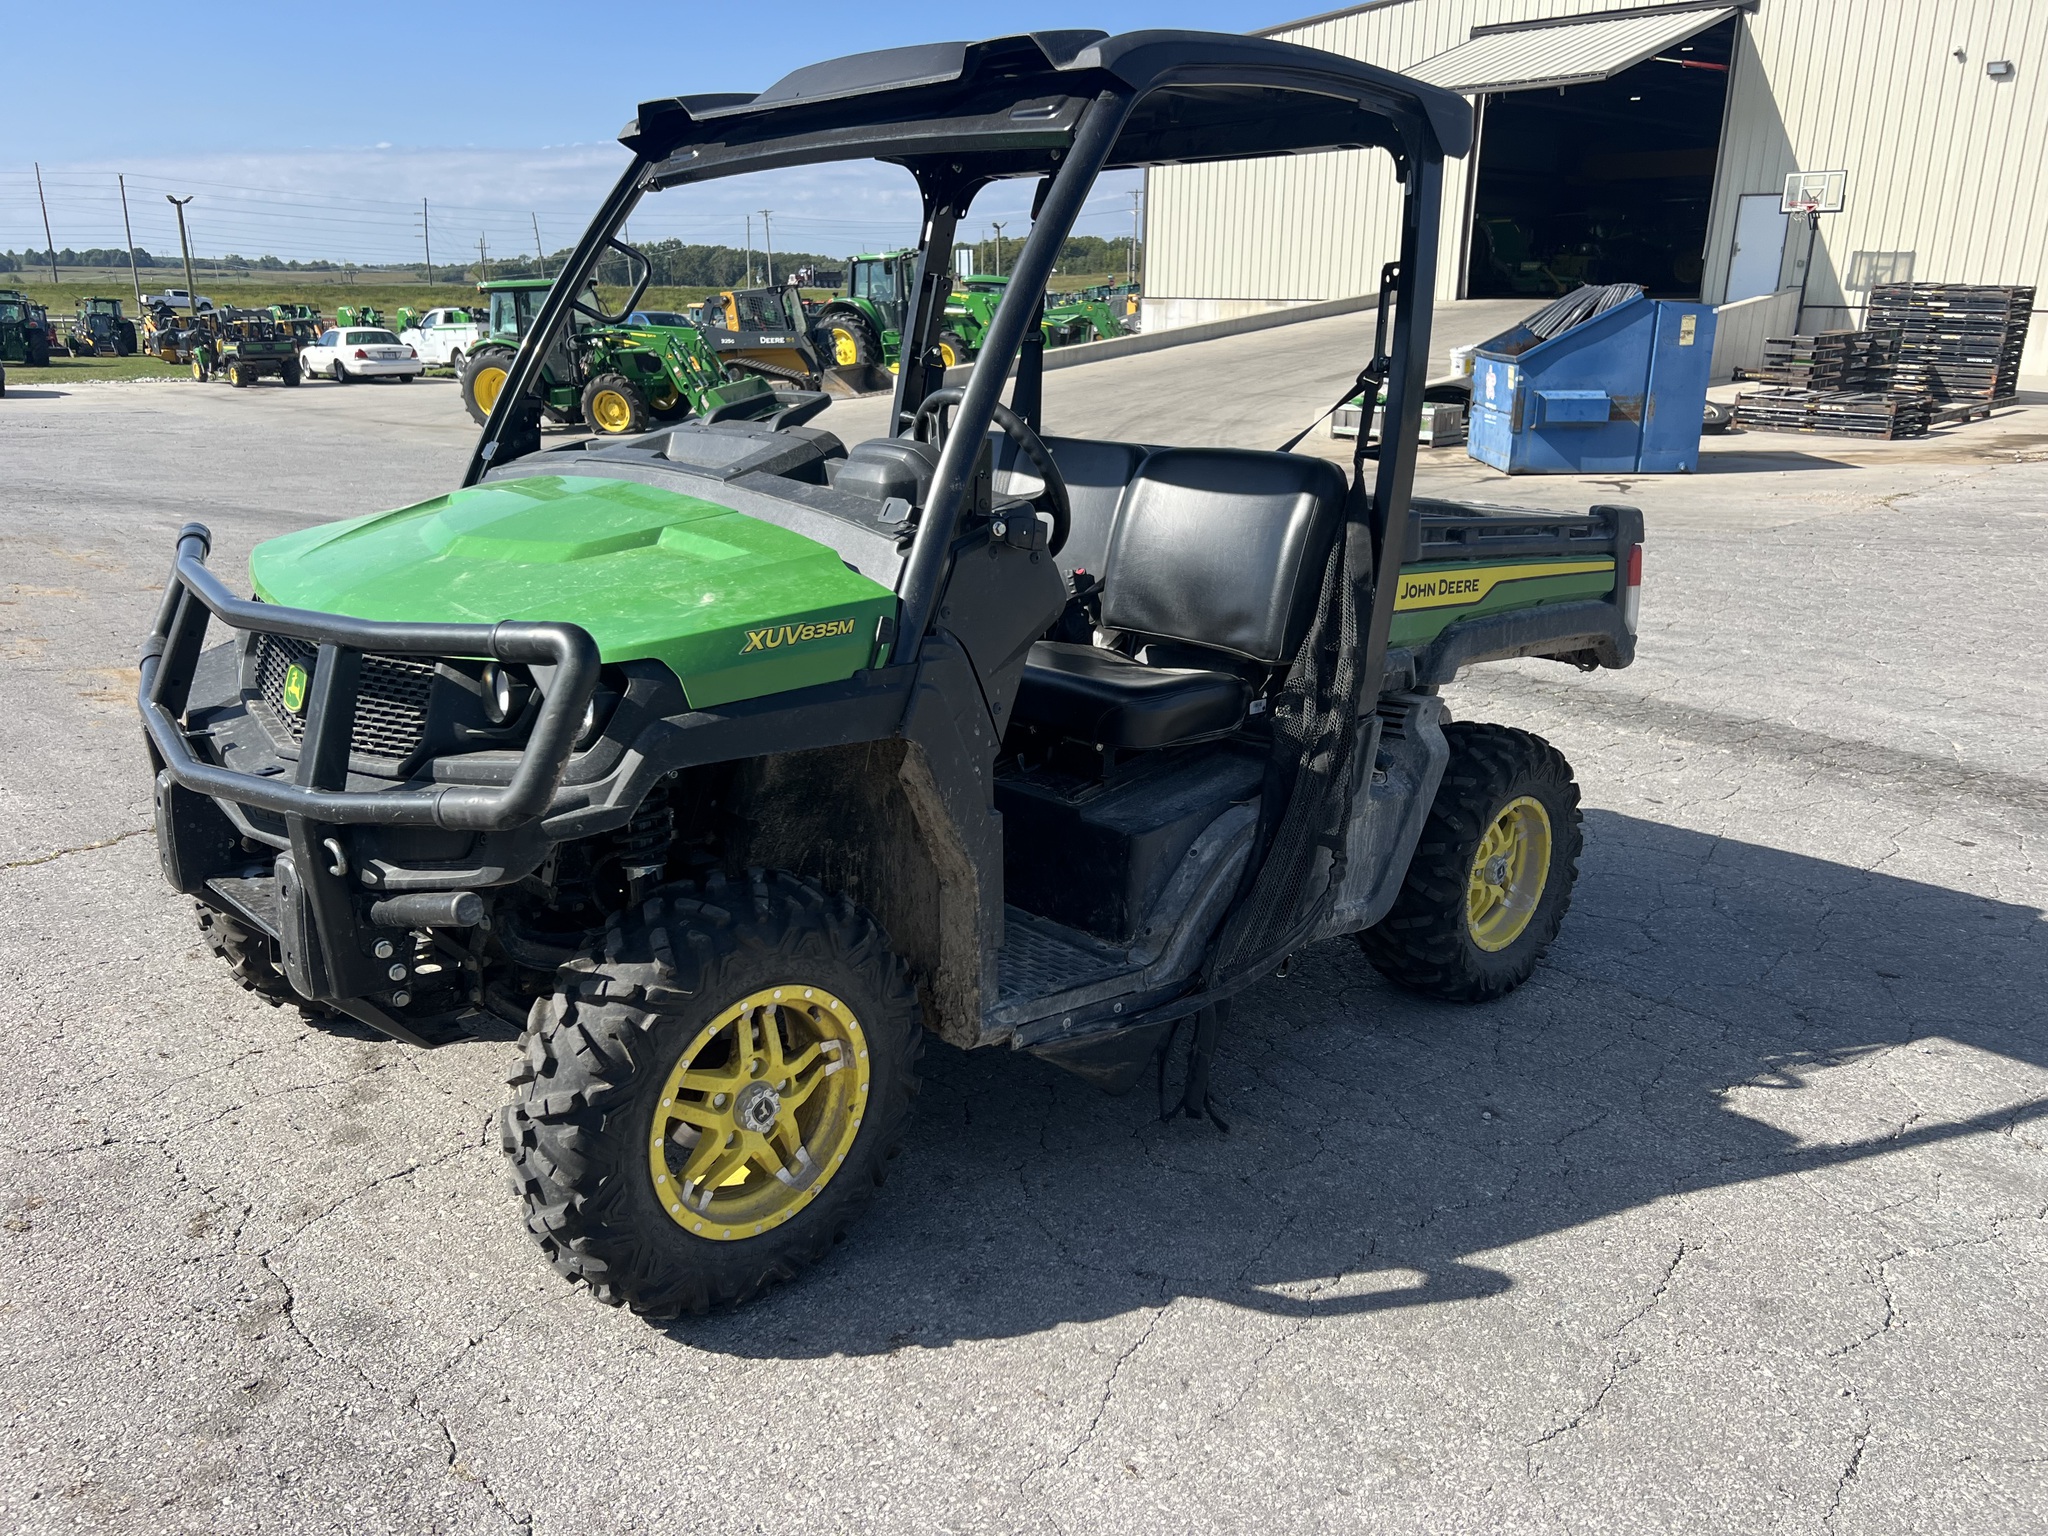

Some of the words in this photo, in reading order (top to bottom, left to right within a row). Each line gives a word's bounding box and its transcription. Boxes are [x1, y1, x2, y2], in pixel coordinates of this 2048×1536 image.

[1400, 581, 1436, 600] JOHN
[1438, 578, 1480, 596] DEERE
[743, 618, 856, 653] XUV835M
